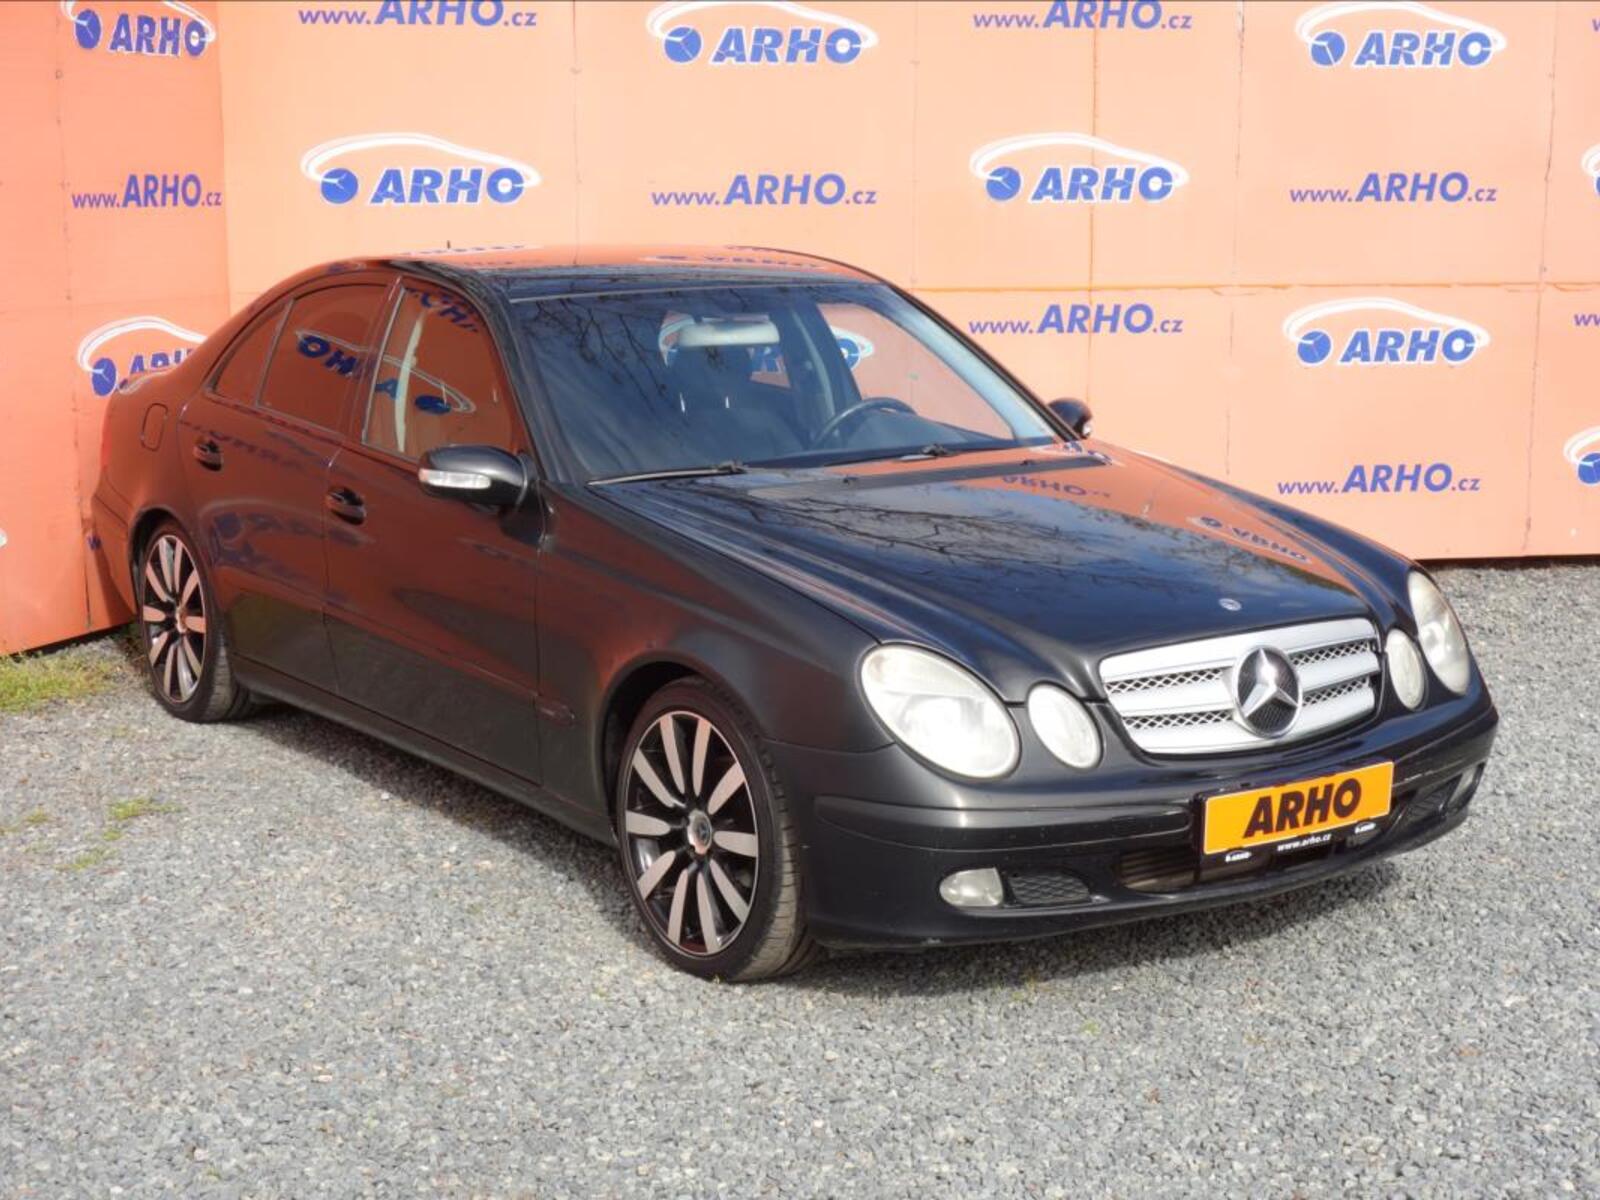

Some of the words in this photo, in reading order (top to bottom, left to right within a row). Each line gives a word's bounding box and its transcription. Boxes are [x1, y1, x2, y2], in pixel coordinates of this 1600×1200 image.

[299, 0, 536, 27] www.ARHO.cz
[973, 0, 1192, 30] www.ARHO.cz
[110, 14, 207, 56] ARHO
[714, 28, 861, 63] ARHO
[1355, 31, 1491, 66] ARHO
[72, 173, 222, 208] www.ARHO.cz
[371, 167, 524, 204] ARHO
[652, 172, 877, 206] www.ARHO.cz
[1032, 165, 1173, 201] ARHO
[1290, 171, 1497, 203] www.ARHO.cz
[970, 302, 1183, 335] www.ARHO.cz
[1341, 328, 1476, 363] ARHO
[1277, 462, 1480, 494] www.ARHO.cz
[1242, 778, 1362, 839] ARHO
